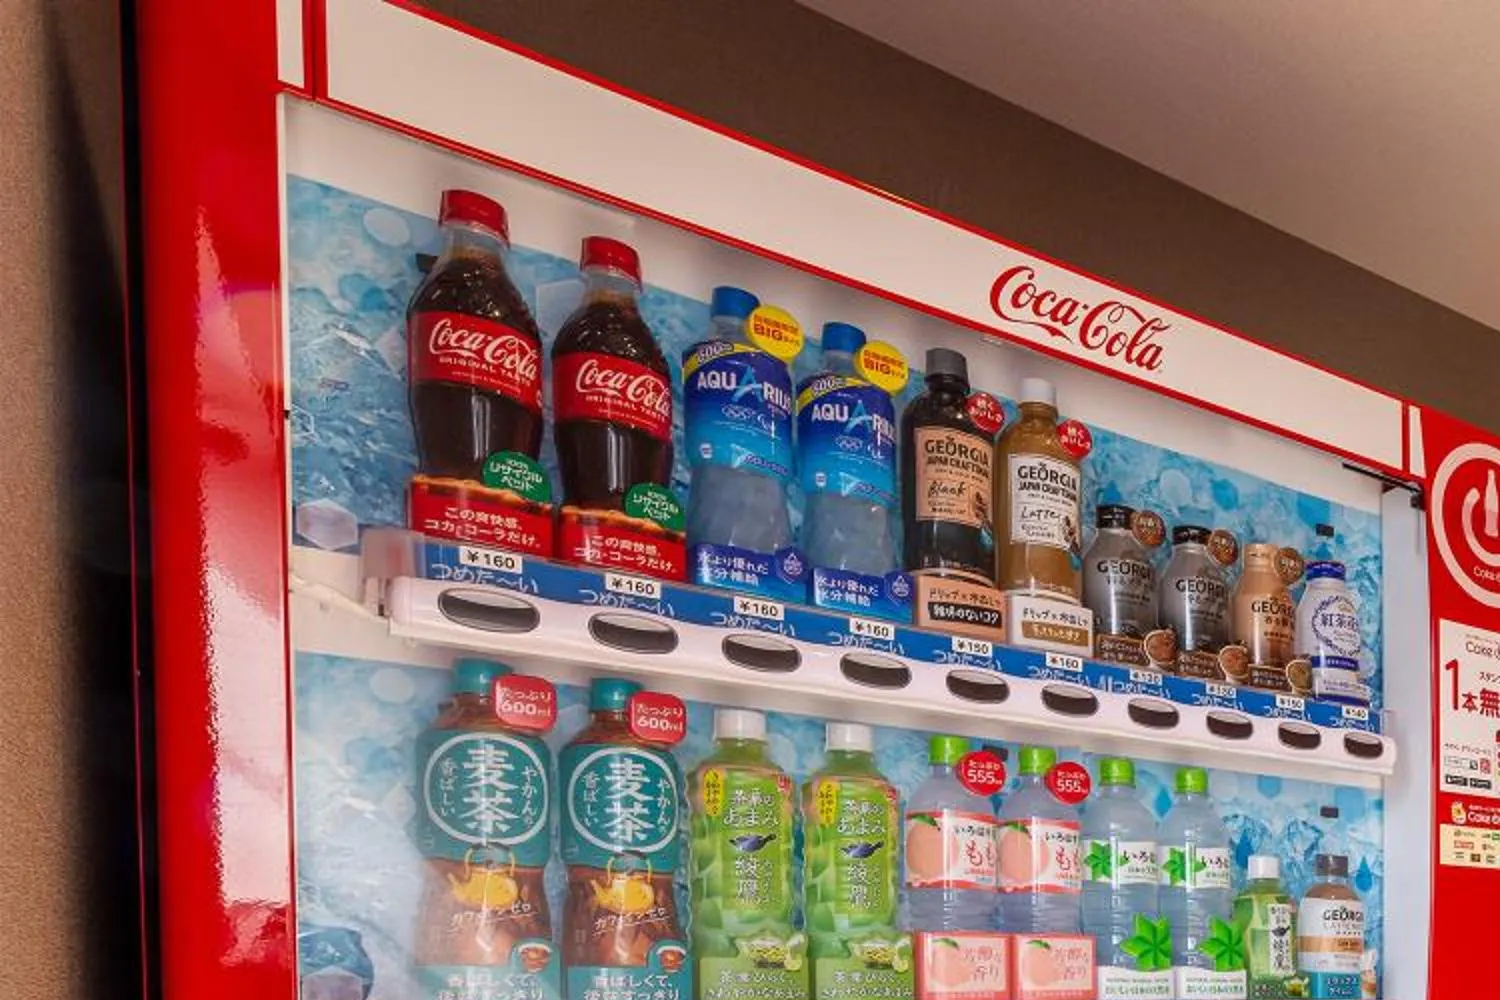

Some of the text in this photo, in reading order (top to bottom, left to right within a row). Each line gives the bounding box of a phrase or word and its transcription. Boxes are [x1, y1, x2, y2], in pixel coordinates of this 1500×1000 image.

[990, 265, 1172, 371] Coca-Cola
[429, 318, 537, 379] Coca-Cola
[576, 360, 672, 416] Coca-Cola
[467, 550, 516, 569] ¥160
[611, 578, 655, 595] ¥160
[740, 601, 778, 617] ¥160
[459, 743, 520, 834] 麦茶
[604, 758, 656, 842] 麦茶
